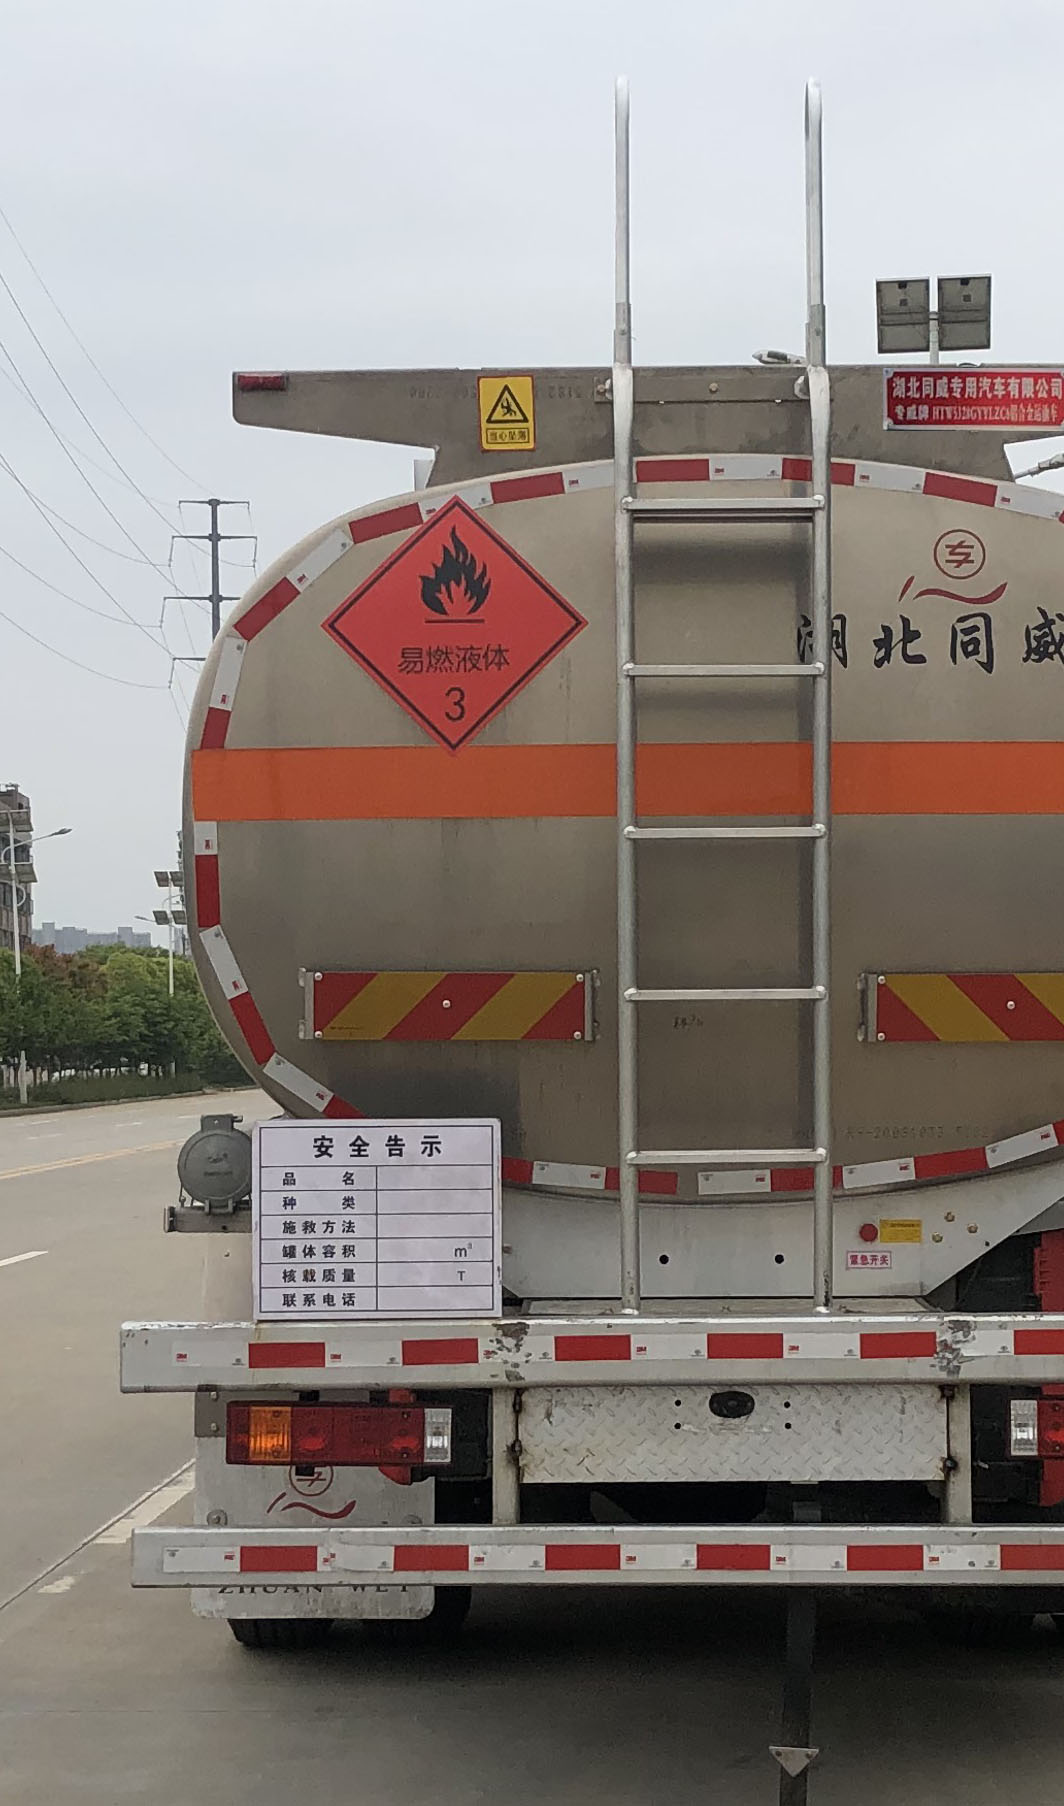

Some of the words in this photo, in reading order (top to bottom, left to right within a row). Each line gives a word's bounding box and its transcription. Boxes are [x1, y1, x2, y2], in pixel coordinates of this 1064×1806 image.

[892, 376, 1063, 399] 湖北同威专用汽车有限公司
[397, 644, 510, 674] 易燃液体
[445, 687, 465, 722] 3
[313, 1135, 442, 1159] 安全告示
[282, 1171, 355, 1186] 品名
[282, 1196, 356, 1210] 种类
[282, 1220, 356, 1234] 施救方法
[282, 1244, 356, 1259] 罐体容积
[849, 1254, 889, 1266] 紧急开关
[282, 1269, 356, 1283] 核载质量
[457, 1271, 466, 1281] T
[282, 1293, 356, 1307] 联系电话
